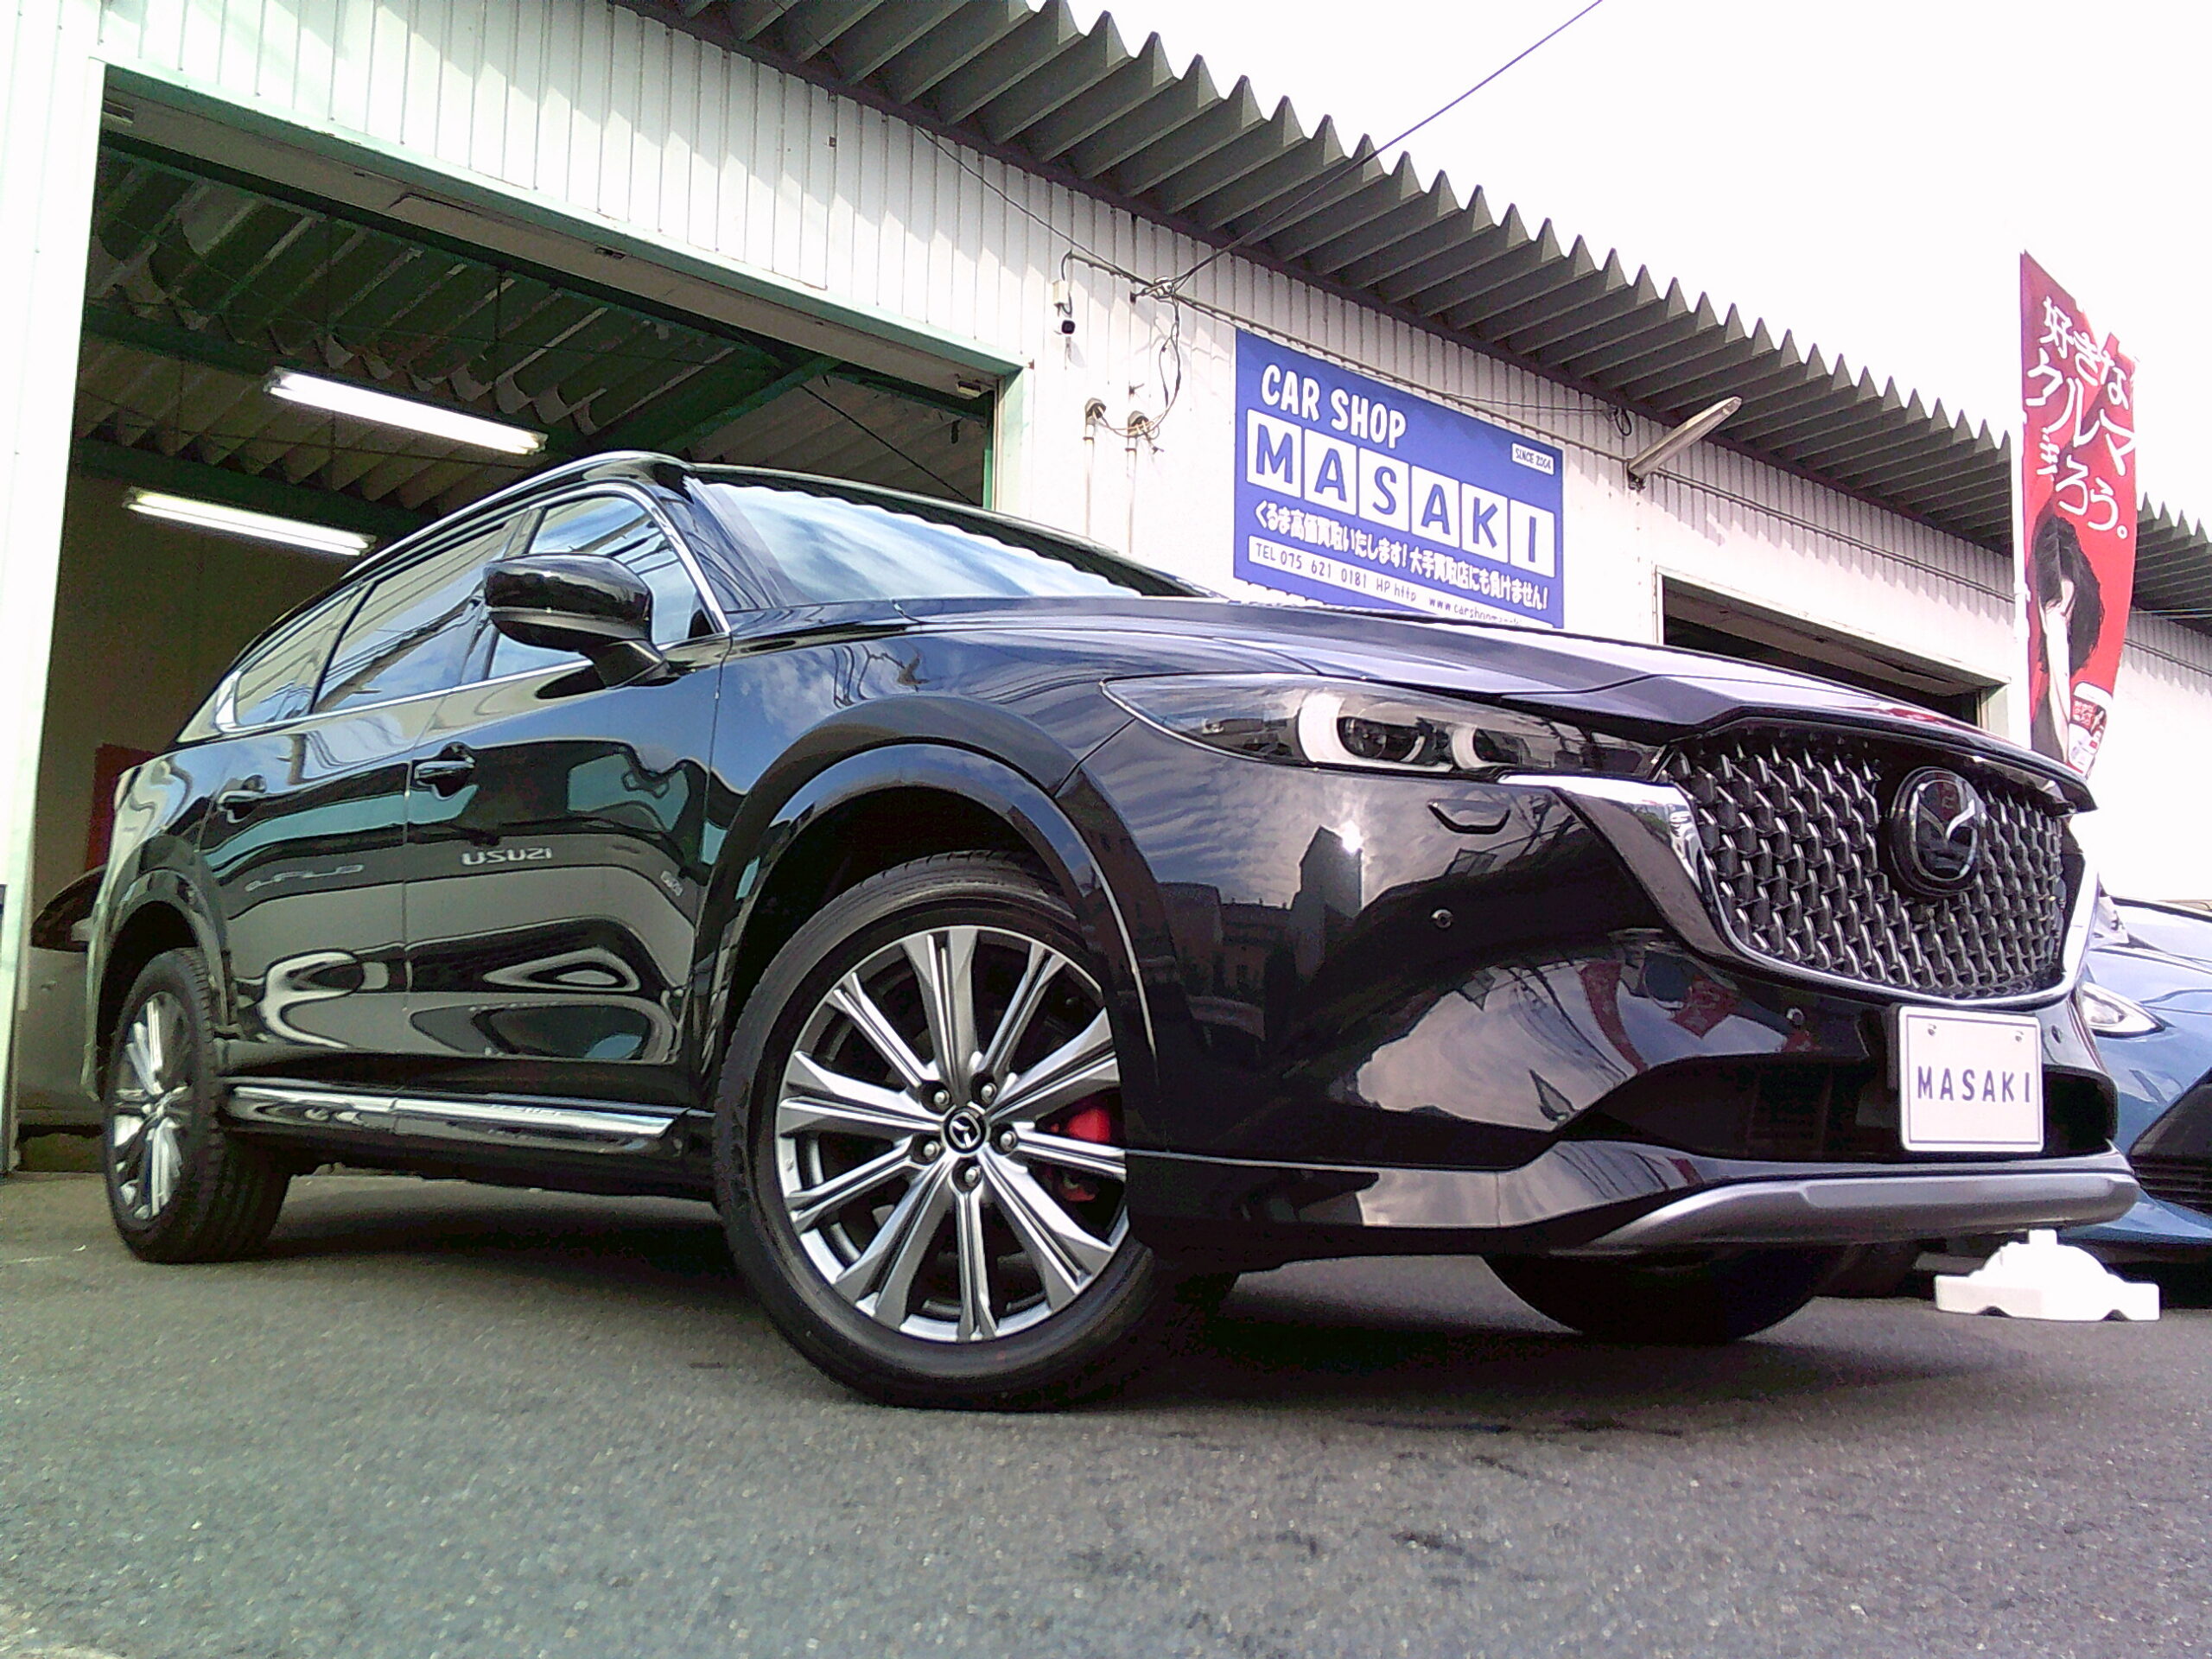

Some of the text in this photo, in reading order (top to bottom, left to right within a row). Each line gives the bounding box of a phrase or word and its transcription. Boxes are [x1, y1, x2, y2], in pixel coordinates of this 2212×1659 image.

[2038, 296, 2131, 410] 好きな
[1261, 364, 1408, 449] CAR SHOP
[2024, 347, 2138, 477] クルマ
[1255, 422, 1536, 564] MASAKI
[1515, 448, 1534, 464] SINCE
[1255, 542, 1275, 562] TEL
[1280, 550, 1302, 569] 075
[1311, 560, 1332, 579] 621
[1340, 568, 1367, 589] 0181
[1376, 578, 1390, 593] HP
[1917, 1065, 2031, 1103] MASAKI
